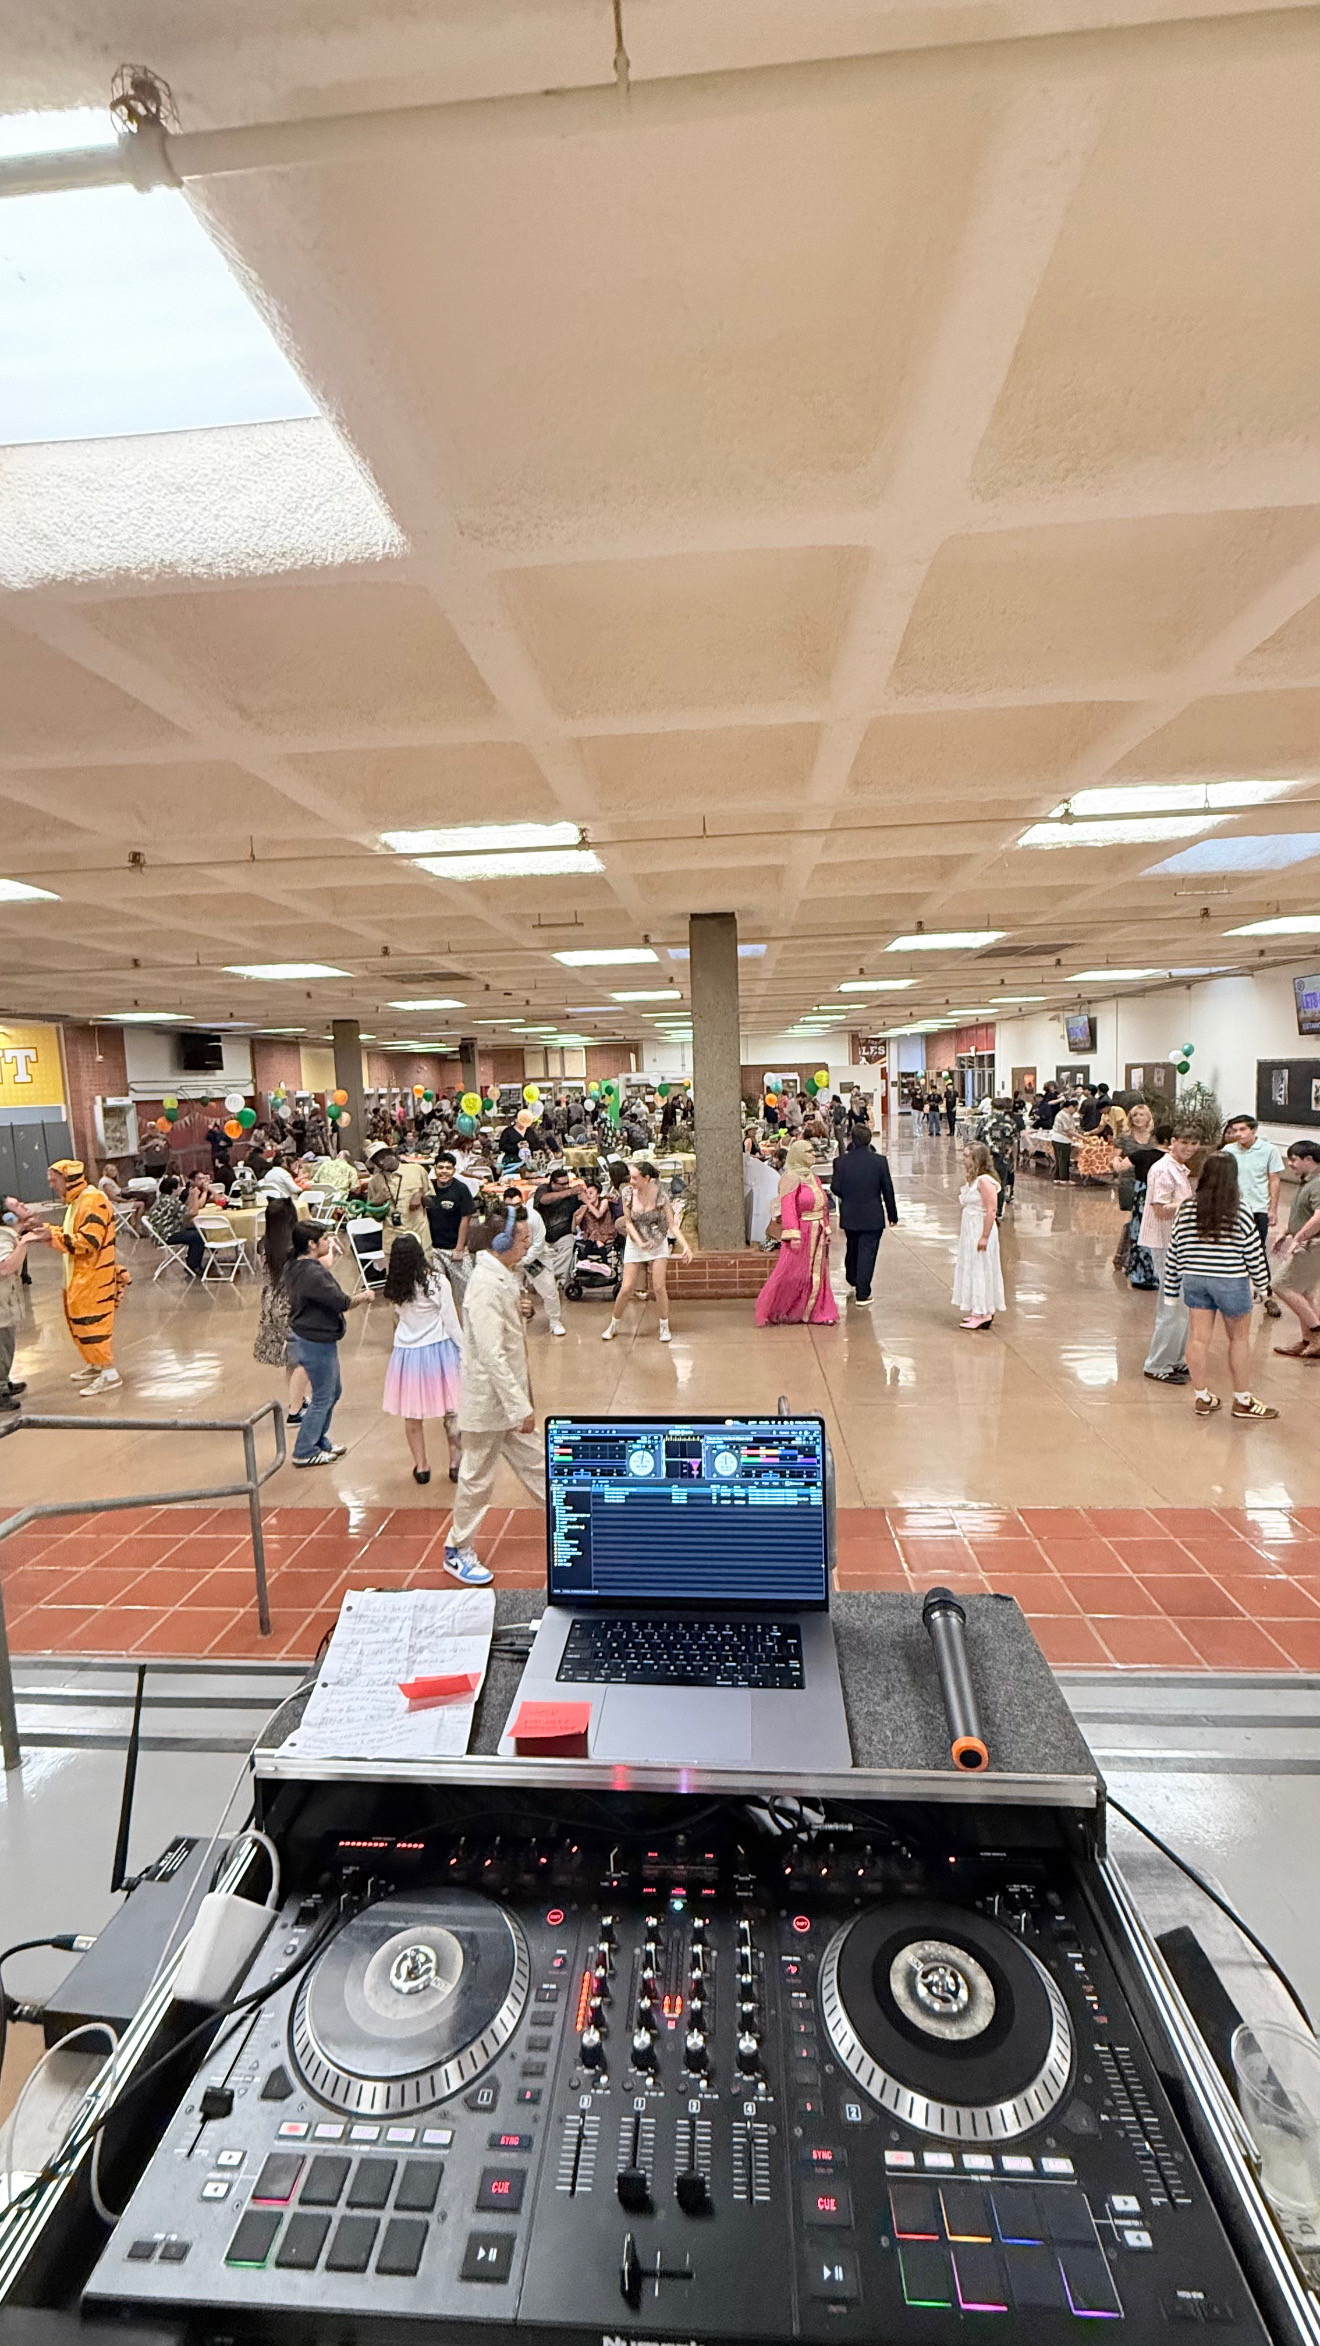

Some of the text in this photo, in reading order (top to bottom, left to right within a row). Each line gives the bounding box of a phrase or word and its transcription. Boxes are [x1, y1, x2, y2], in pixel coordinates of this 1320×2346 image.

[858, 1045, 886, 1056] LES
[0, 1047, 39, 1084] T
[500, 2135, 519, 2146] SYNC
[812, 2149, 832, 2160] SYNC
[491, 2180, 510, 2194] CUE
[817, 2197, 837, 2212] CUE
